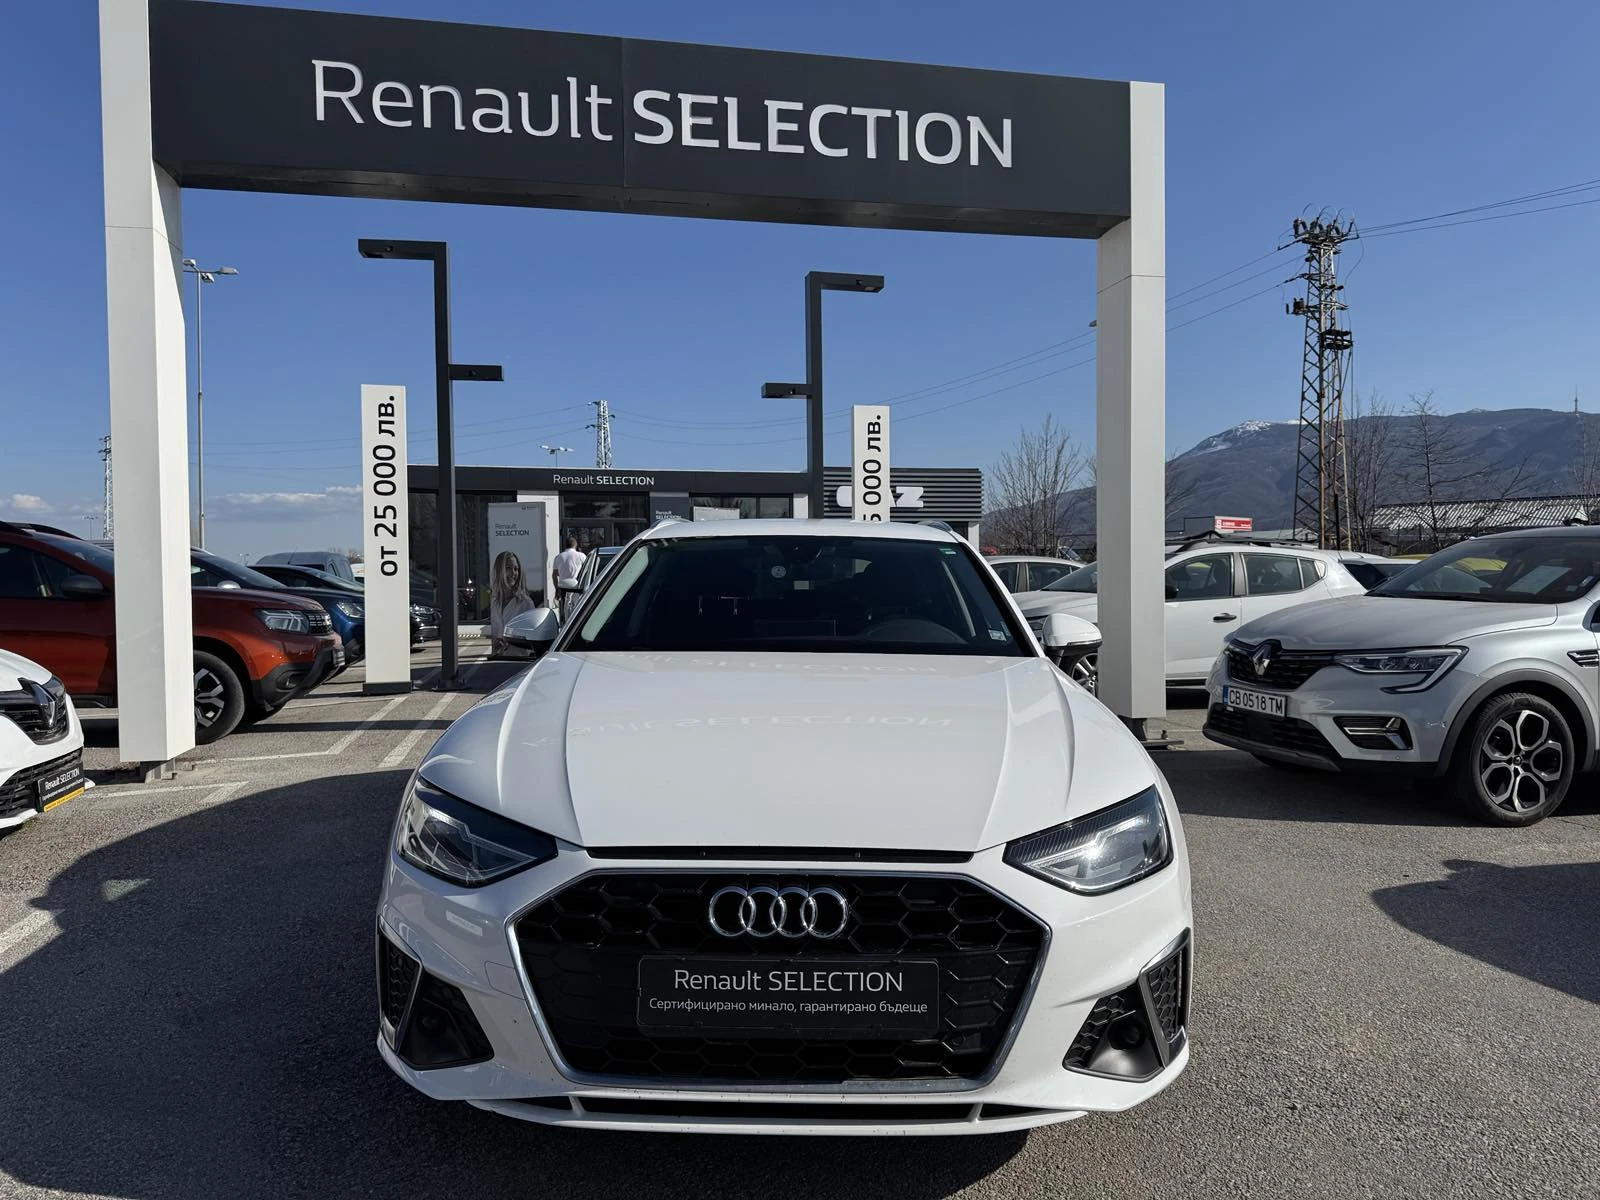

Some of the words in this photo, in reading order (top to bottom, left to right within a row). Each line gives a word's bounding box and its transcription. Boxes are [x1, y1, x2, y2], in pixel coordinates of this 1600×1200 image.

[312, 59, 612, 141] Renault
[634, 89, 1012, 167] SELECTION
[377, 395, 395, 437] лв.
[867, 415, 881, 452] лв.
[372, 445, 396, 496] 000
[553, 474, 594, 484] Renault
[597, 476, 655, 486] SELECTION
[862, 459, 881, 505] 000
[373, 505, 397, 537] 25
[380, 545, 398, 576] от
[1229, 689, 1241, 706] CB
[1242, 692, 1267, 712] 0518
[1268, 696, 1284, 715] TM
[60, 767, 80, 784] SELECTION
[674, 969, 762, 991] Renault
[768, 971, 903, 992] SELECTION
[649, 998, 746, 1013] Сертифицирано
[748, 1002, 797, 1013] минало,
[799, 1003, 877, 1015] гарантирано
[879, 1000, 928, 1014] бъдеще
